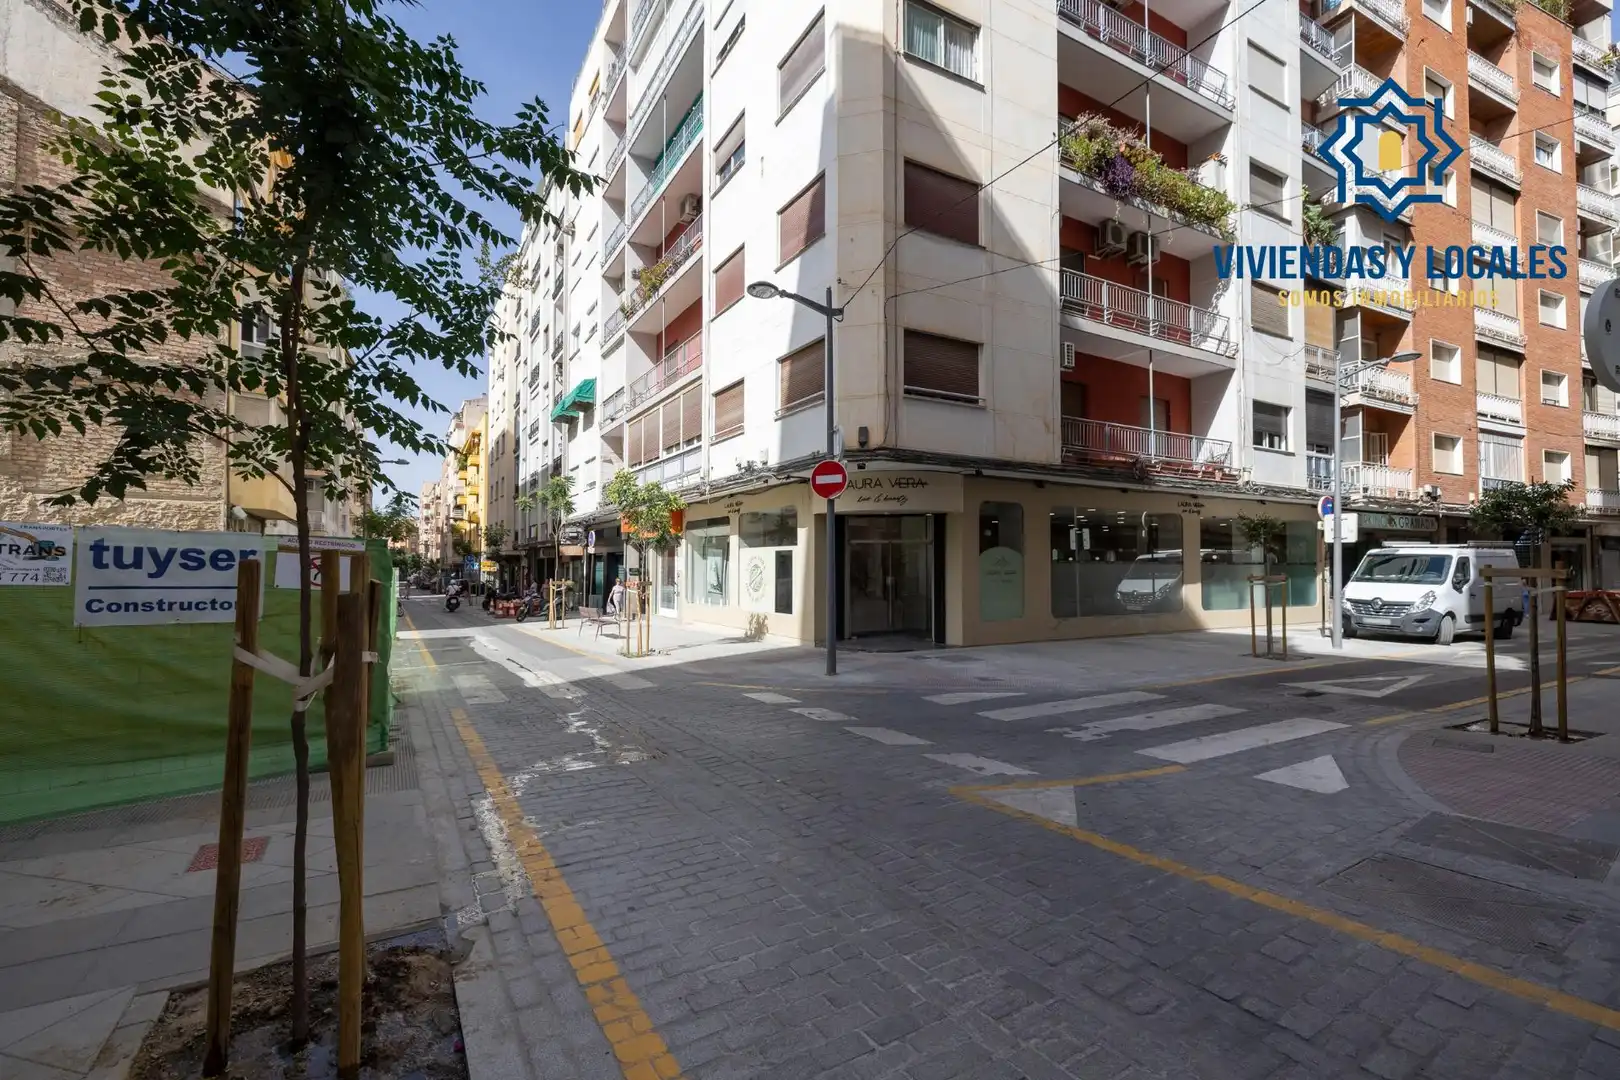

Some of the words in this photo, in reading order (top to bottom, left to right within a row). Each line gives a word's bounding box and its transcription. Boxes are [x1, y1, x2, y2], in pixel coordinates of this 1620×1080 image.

[847, 477, 883, 489] AURA
[888, 477, 927, 489] VERA
[9, 572, 39, 582] 774
[85, 598, 237, 613] Constructo
